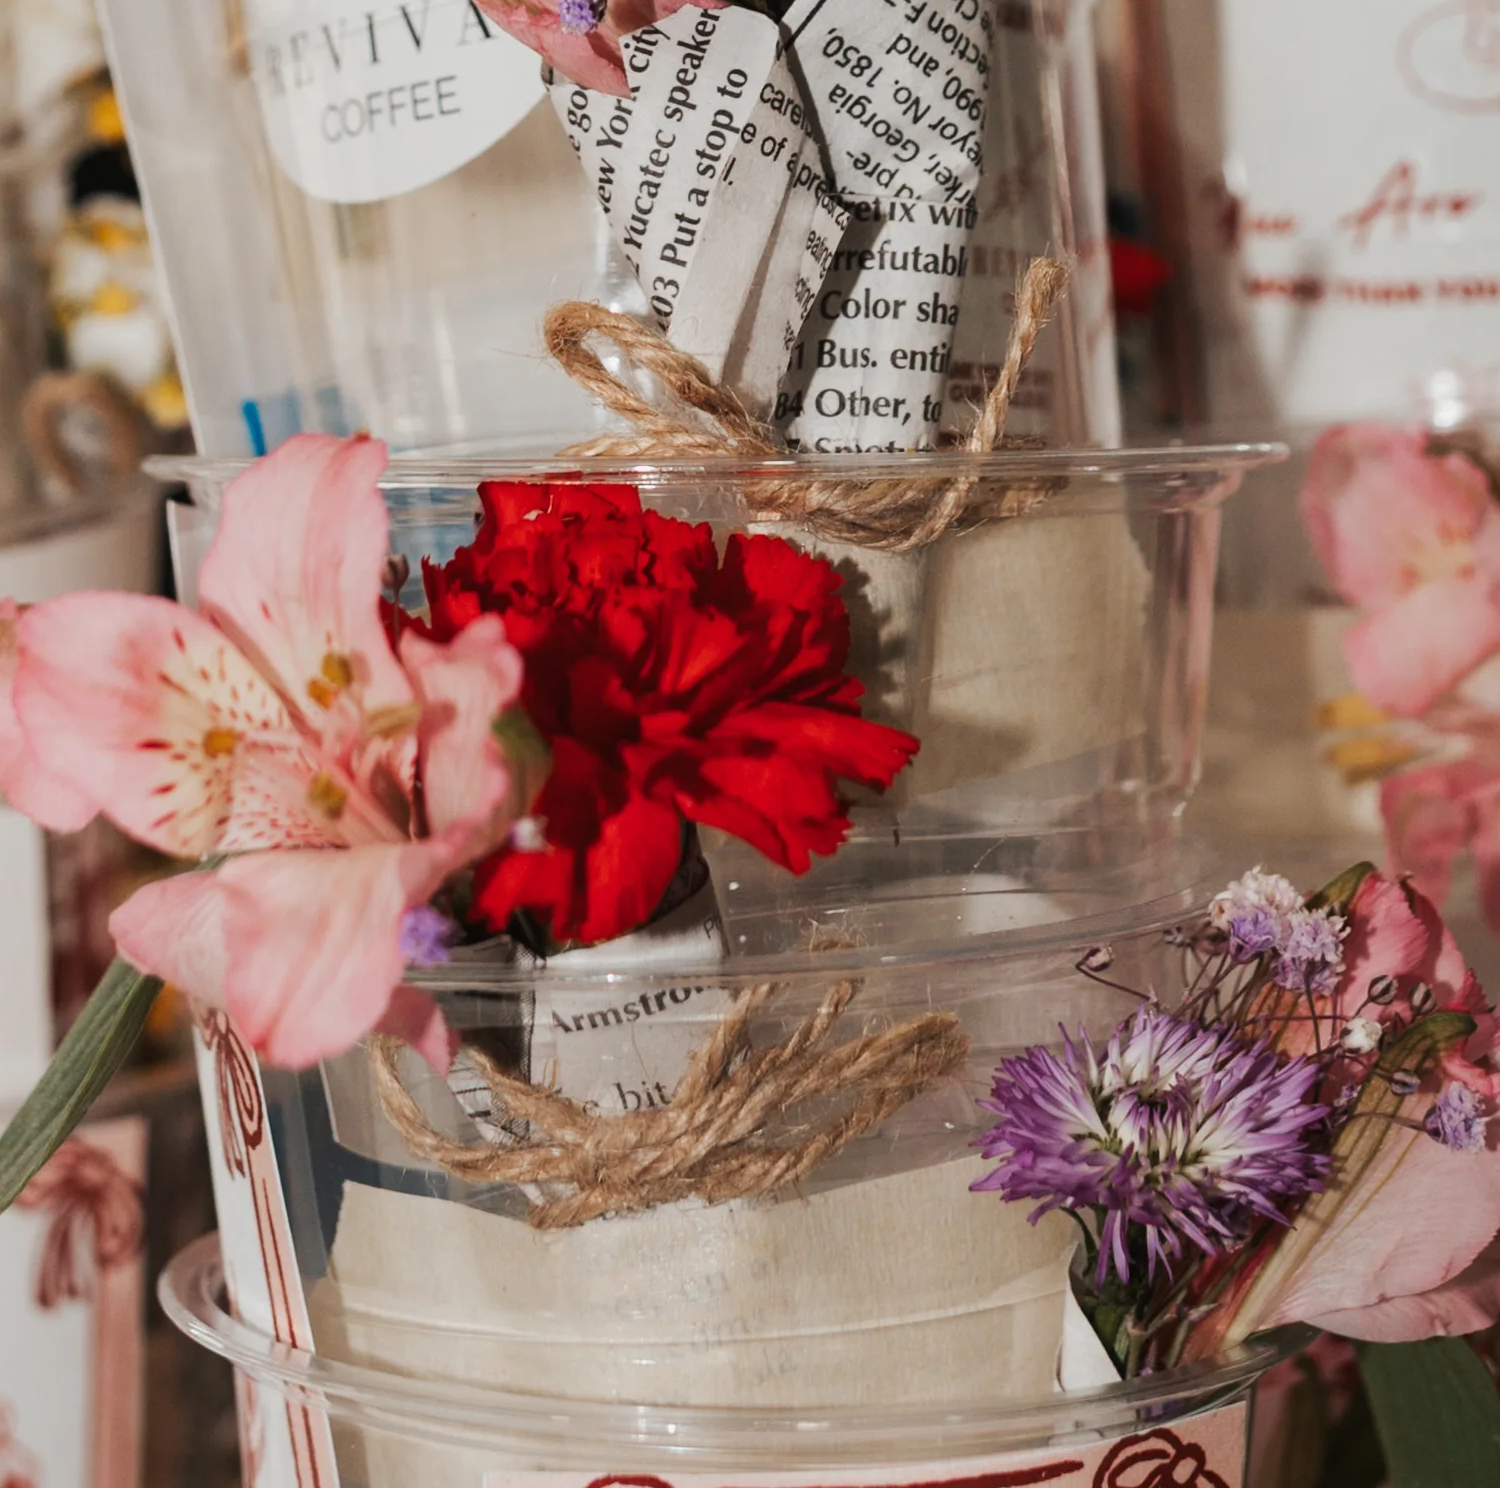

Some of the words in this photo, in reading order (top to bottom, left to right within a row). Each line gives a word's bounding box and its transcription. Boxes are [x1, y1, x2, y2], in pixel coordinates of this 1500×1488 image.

[624, 25, 670, 73] city
[823, 28, 883, 87] 1850,
[886, 33, 938, 77] and
[717, 69, 748, 98] to
[893, 80, 931, 124] No.
[321, 76, 461, 144] COFFEE
[829, 84, 920, 161] Georgia
[696, 110, 741, 178] stop
[760, 136, 788, 161] of
[624, 129, 676, 250] Yucatec
[846, 152, 899, 188] pre-
[688, 188, 709, 207] a
[660, 213, 701, 268] Put
[831, 239, 967, 277] rrefutabl
[820, 288, 906, 320] Color
[818, 339, 877, 368] Bus.
[815, 386, 911, 426] Other,
